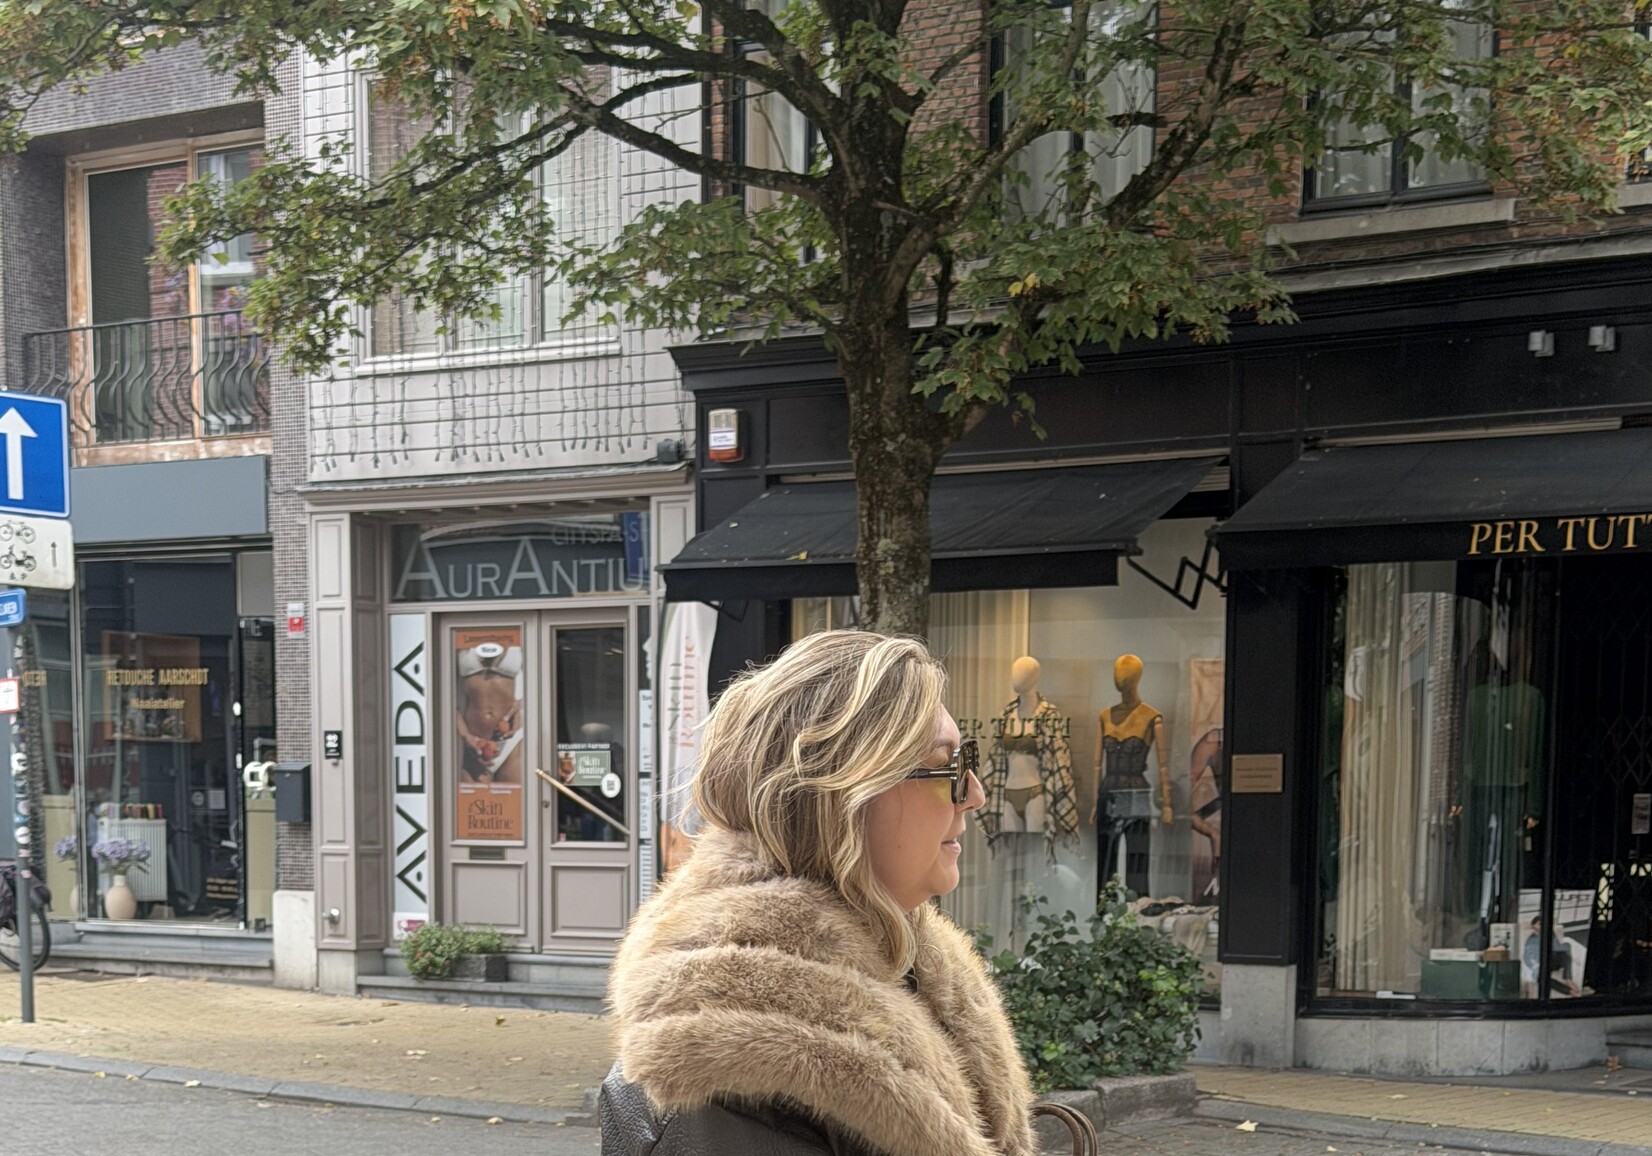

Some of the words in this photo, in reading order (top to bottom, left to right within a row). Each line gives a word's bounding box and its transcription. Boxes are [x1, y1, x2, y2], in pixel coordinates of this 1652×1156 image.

[1467, 519, 1546, 556] PER
[1556, 513, 1652, 551] TUT
[394, 536, 645, 599] AURANTIU
[105, 669, 155, 686] RETOUCHE
[158, 667, 209, 686] AARSCHOT
[958, 718, 986, 739] ER
[393, 641, 428, 904] AVEDA
[475, 799, 503, 816] Skin
[467, 815, 514, 830] Routine
